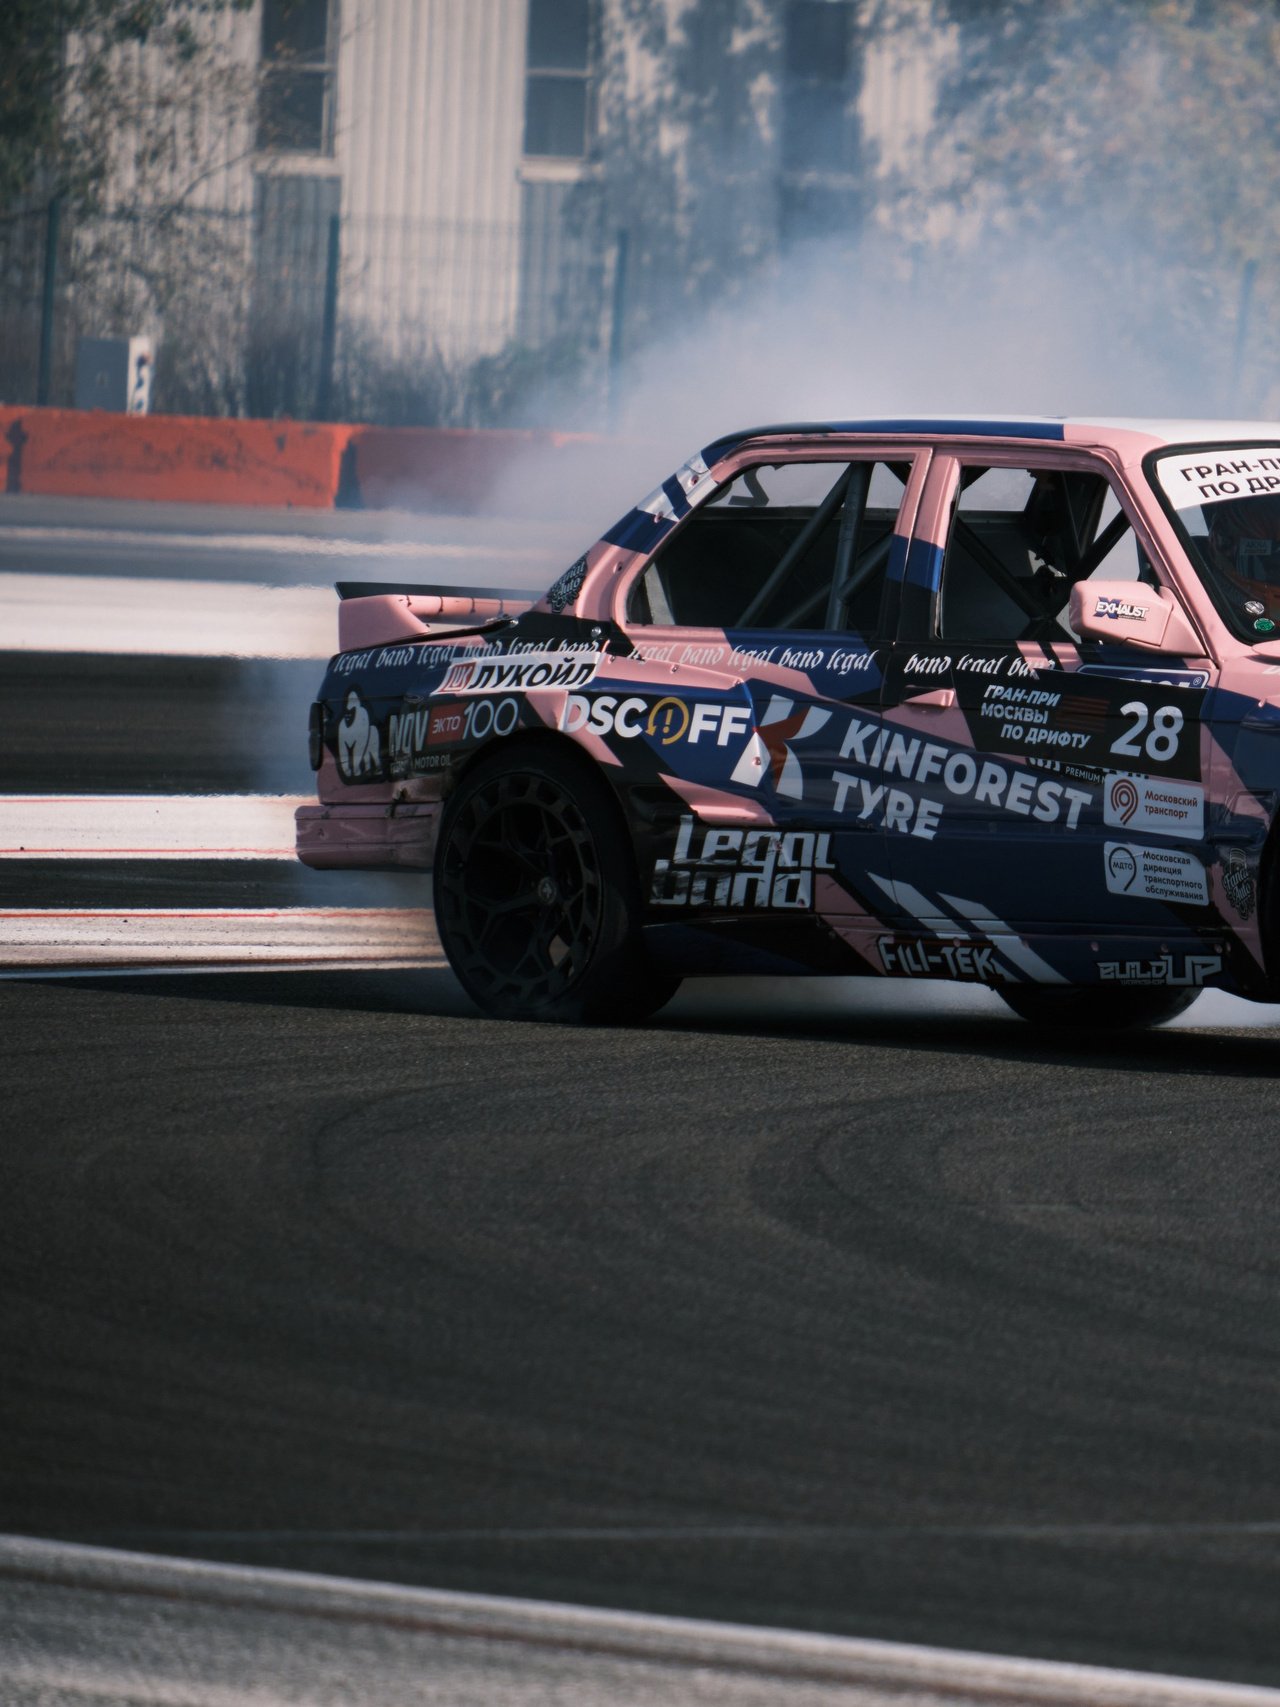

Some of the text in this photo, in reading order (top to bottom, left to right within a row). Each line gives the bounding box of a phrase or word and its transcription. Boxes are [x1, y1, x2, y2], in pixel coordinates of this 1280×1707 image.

[1198, 481, 1240, 498] ПО
[1094, 600, 1149, 618] EXHAUST
[468, 656, 597, 689] ЛУКОЙЛ
[983, 684, 1061, 708] ГРАН-ПРИ
[462, 698, 518, 740] 100
[980, 703, 1048, 725] МОСКВЫ
[432, 716, 461, 735] ЭКТО
[1109, 701, 1185, 761] 28
[1000, 724, 1092, 749] ПО ДРИФТУ
[415, 756, 440, 769] MOTOR
[441, 754, 452, 767] OIL
[838, 719, 1093, 830] KINFOREST
[1065, 766, 1100, 783] PREMIUM
[832, 771, 944, 840] TYRE
[1144, 791, 1198, 807] Московский
[1144, 805, 1189, 819] транспорт
[1112, 861, 1134, 870] МДТО
[1142, 851, 1191, 865] Московская
[1143, 865, 1182, 877] дирекция
[1144, 875, 1203, 889] транспортного
[1145, 886, 1204, 900] обслуживания
